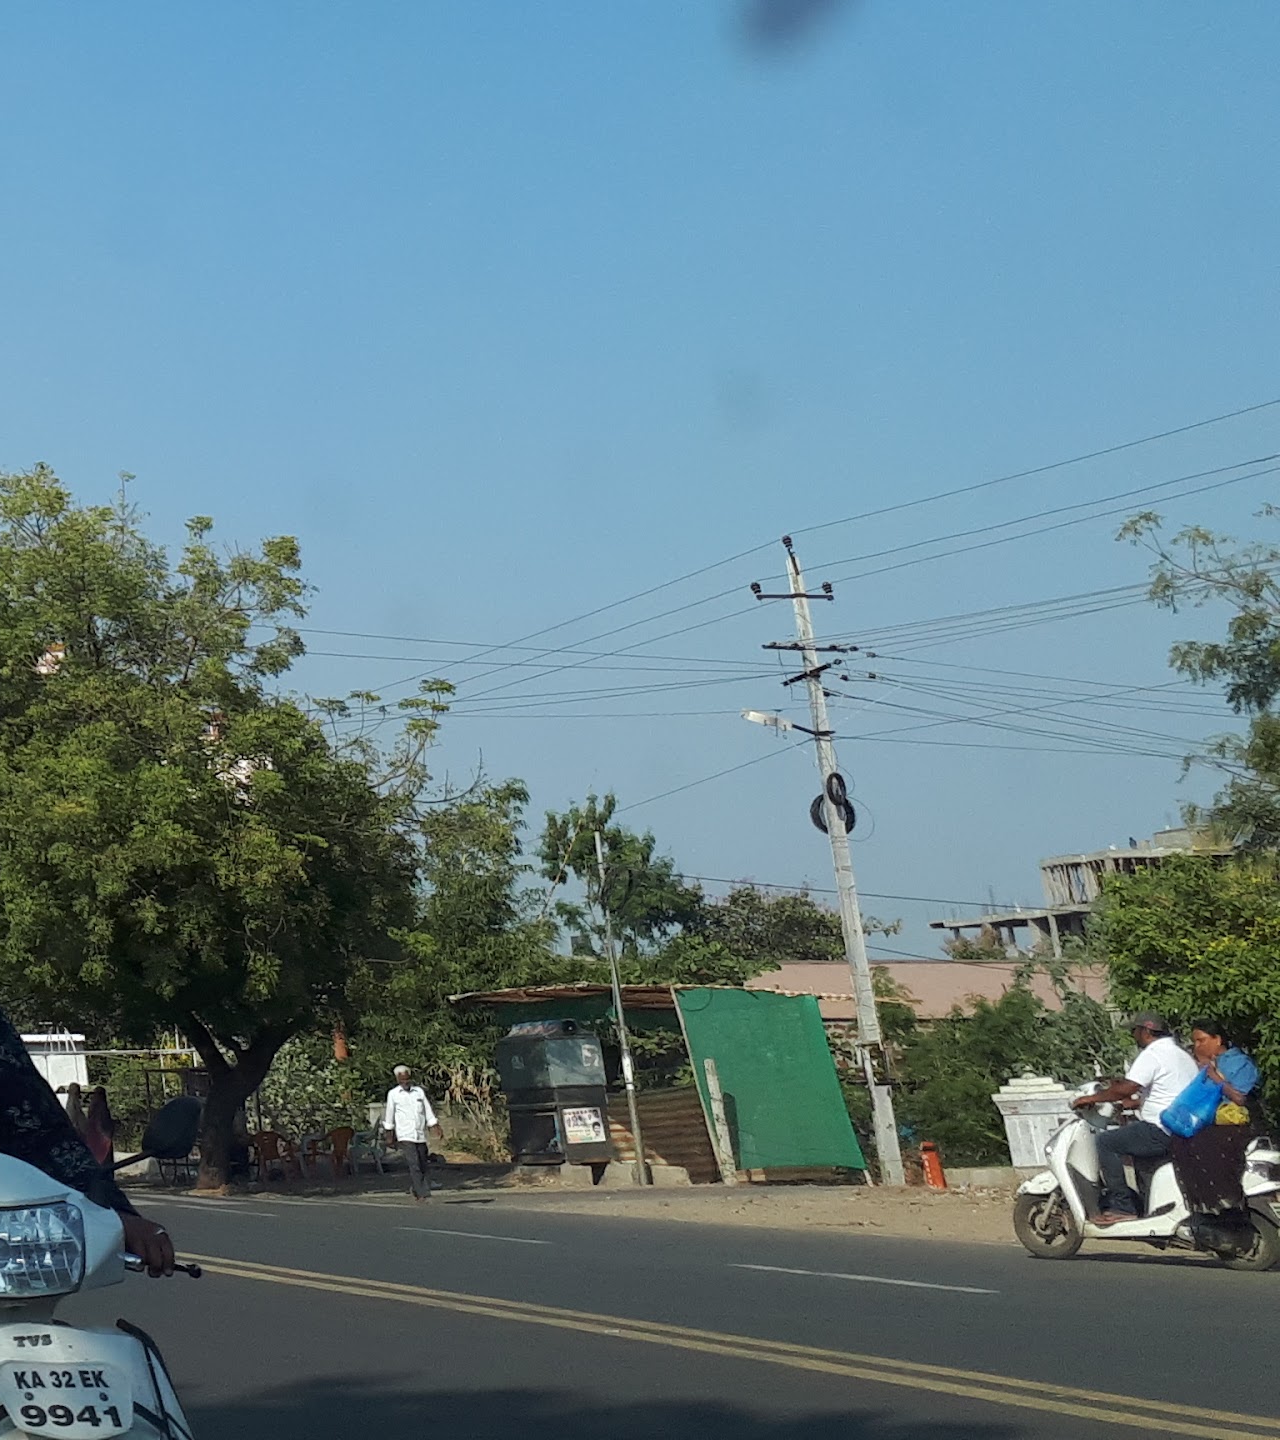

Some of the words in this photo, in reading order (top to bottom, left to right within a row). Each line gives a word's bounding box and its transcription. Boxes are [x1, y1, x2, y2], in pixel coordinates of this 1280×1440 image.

[13, 1334, 52, 1347] TVS
[13, 1370, 46, 1389] KA
[49, 1370, 76, 1388] 32
[78, 1370, 109, 1388] EK
[20, 1405, 122, 1427] 9941
